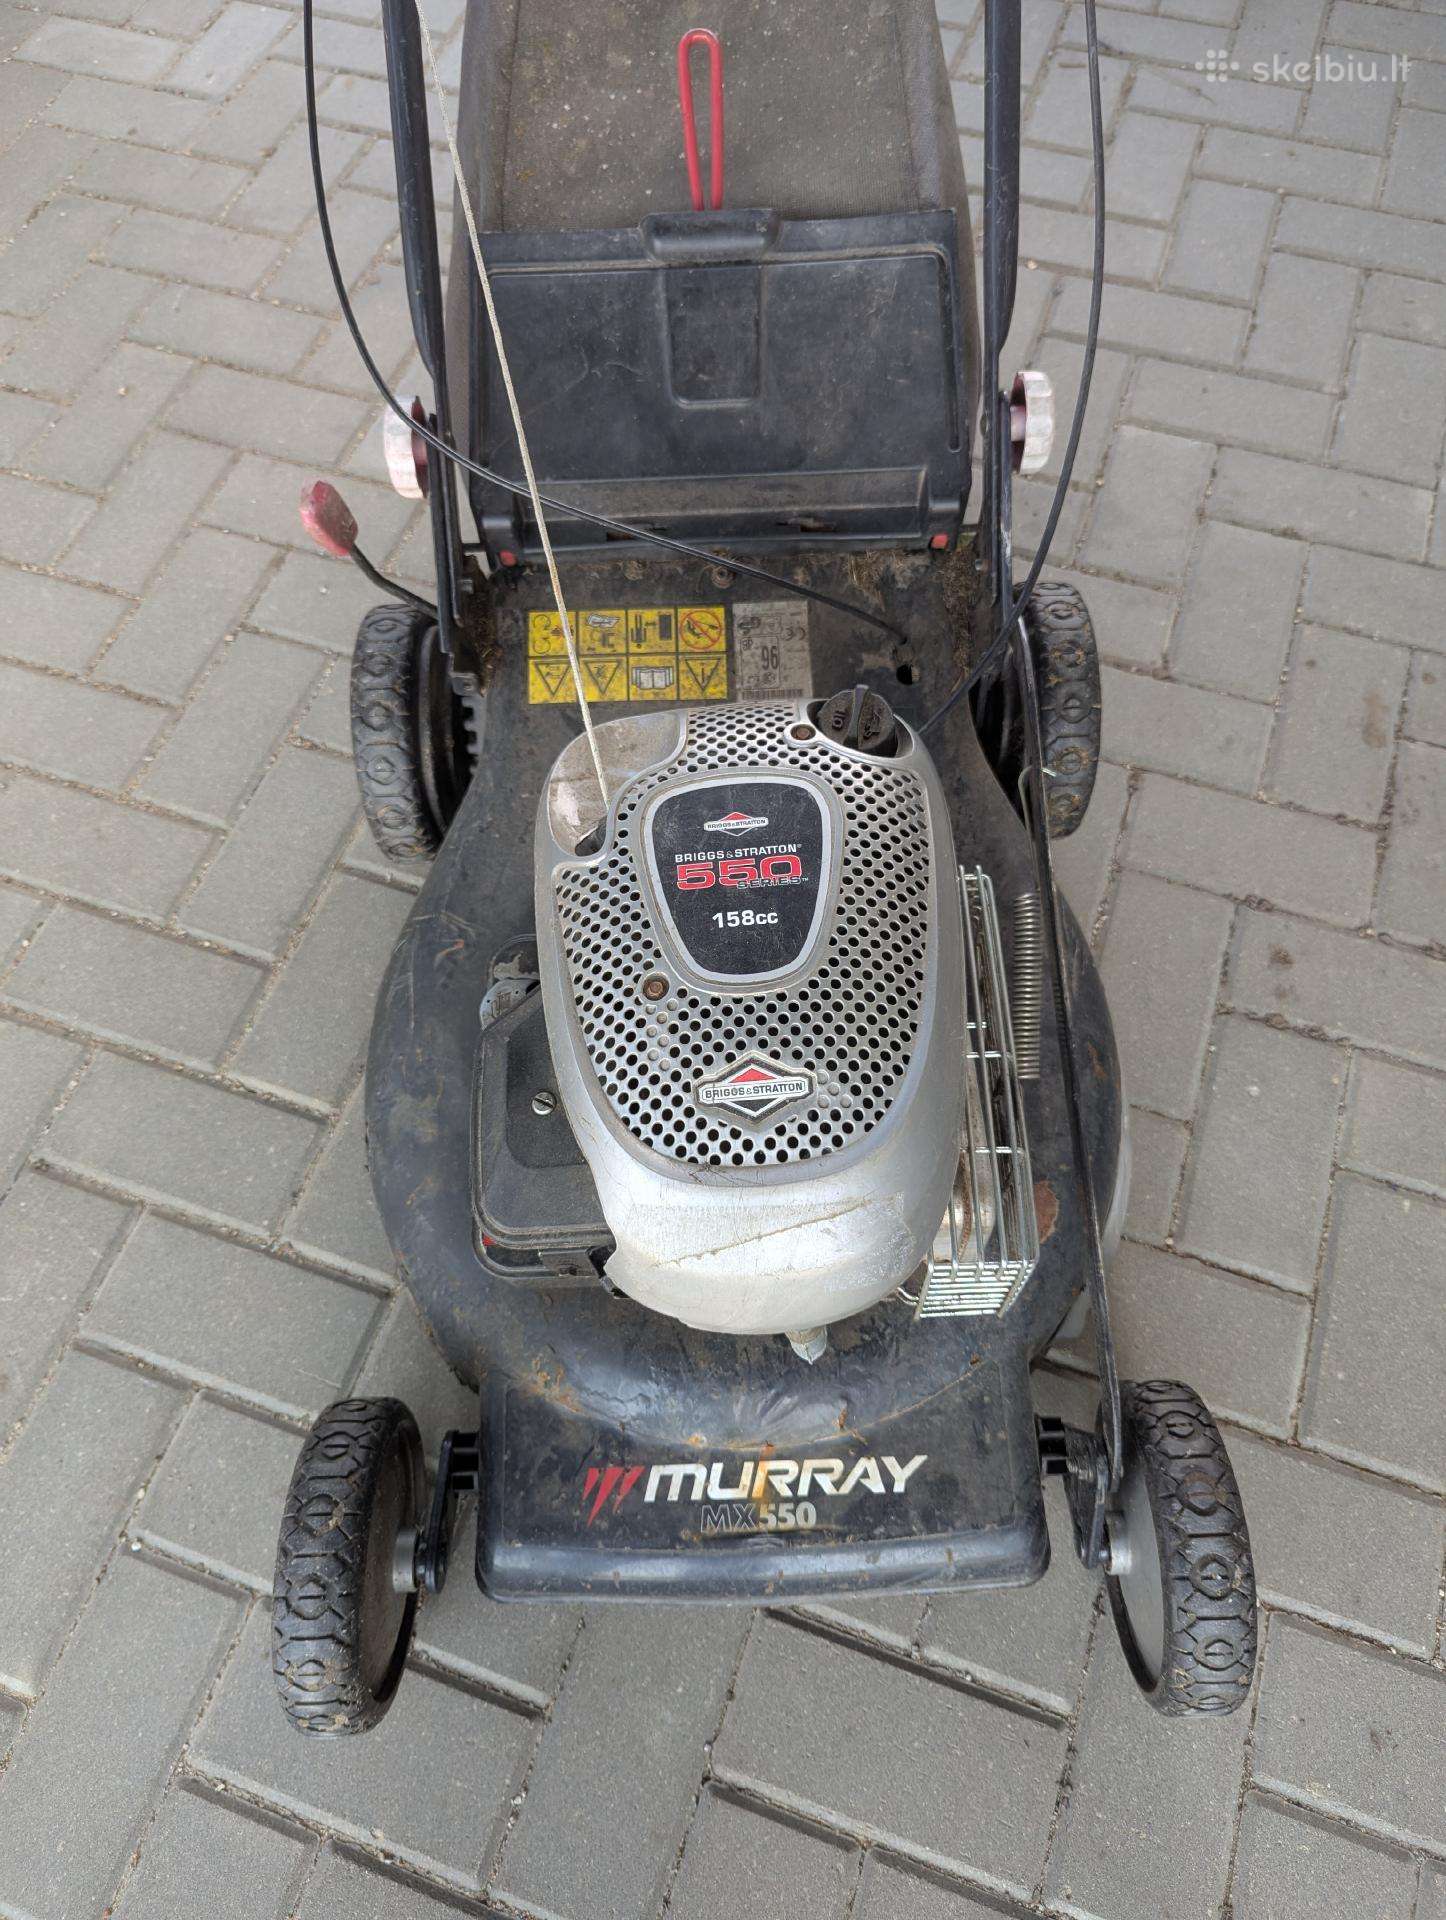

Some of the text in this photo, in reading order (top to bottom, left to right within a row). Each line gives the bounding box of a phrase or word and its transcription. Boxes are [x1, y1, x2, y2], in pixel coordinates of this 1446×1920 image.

[761, 645, 779, 670] 96
[676, 854, 802, 890] 550
[712, 909, 779, 928] 158cc
[644, 1454, 928, 1503] MURRAY
